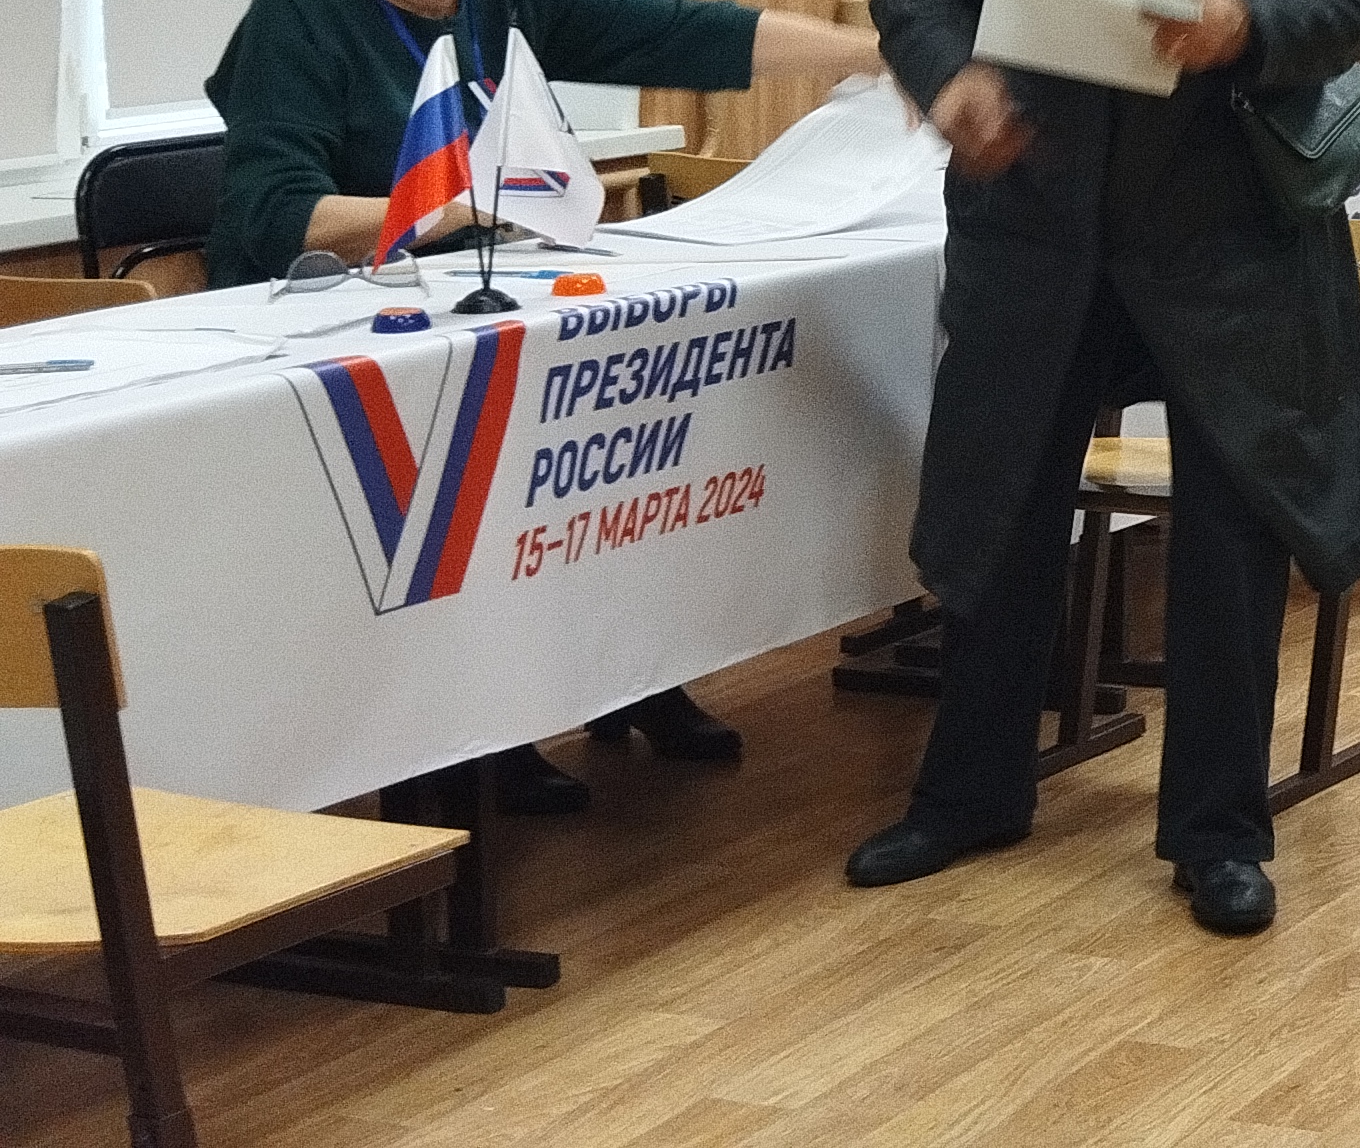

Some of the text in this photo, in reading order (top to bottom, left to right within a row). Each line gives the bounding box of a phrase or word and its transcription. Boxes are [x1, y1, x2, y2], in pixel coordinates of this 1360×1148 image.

[539, 316, 797, 424] ПРЕЗИДЕНТА
[524, 411, 693, 509] РОССИИ
[595, 483, 692, 556] МАРТА
[696, 463, 766, 525] 2024
